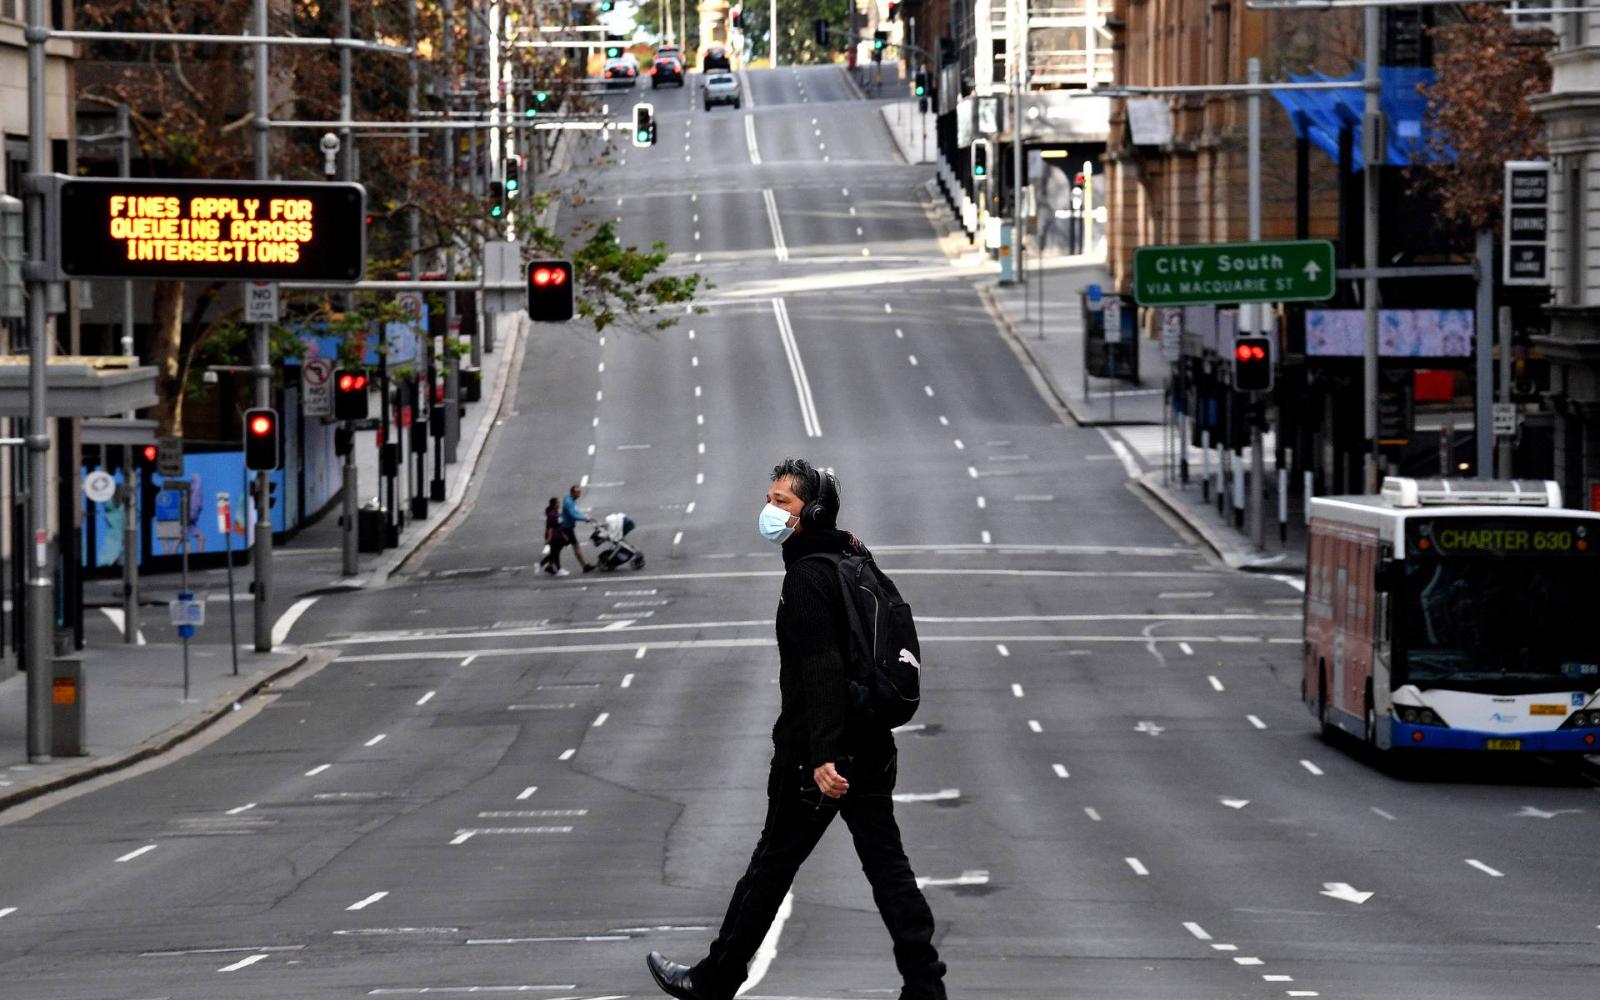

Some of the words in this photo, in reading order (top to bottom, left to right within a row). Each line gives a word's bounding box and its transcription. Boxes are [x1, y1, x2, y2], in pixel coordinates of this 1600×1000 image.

[110, 195, 181, 219] FINES
[190, 197, 260, 219] APPLY
[270, 199, 313, 220] FOR
[110, 217, 220, 240] QUEUEING
[230, 219, 313, 242] ACROSS
[127, 239, 300, 263] INTERSECTIONS
[1155, 256, 1204, 276] City
[1217, 253, 1284, 272] South
[252, 289, 272, 300] NO
[1146, 282, 1173, 295] VIA
[1179, 279, 1268, 294] MACQUARIE
[1275, 277, 1295, 292] ST
[1440, 529, 1530, 549] CHARTER
[1532, 531, 1573, 550] 630
